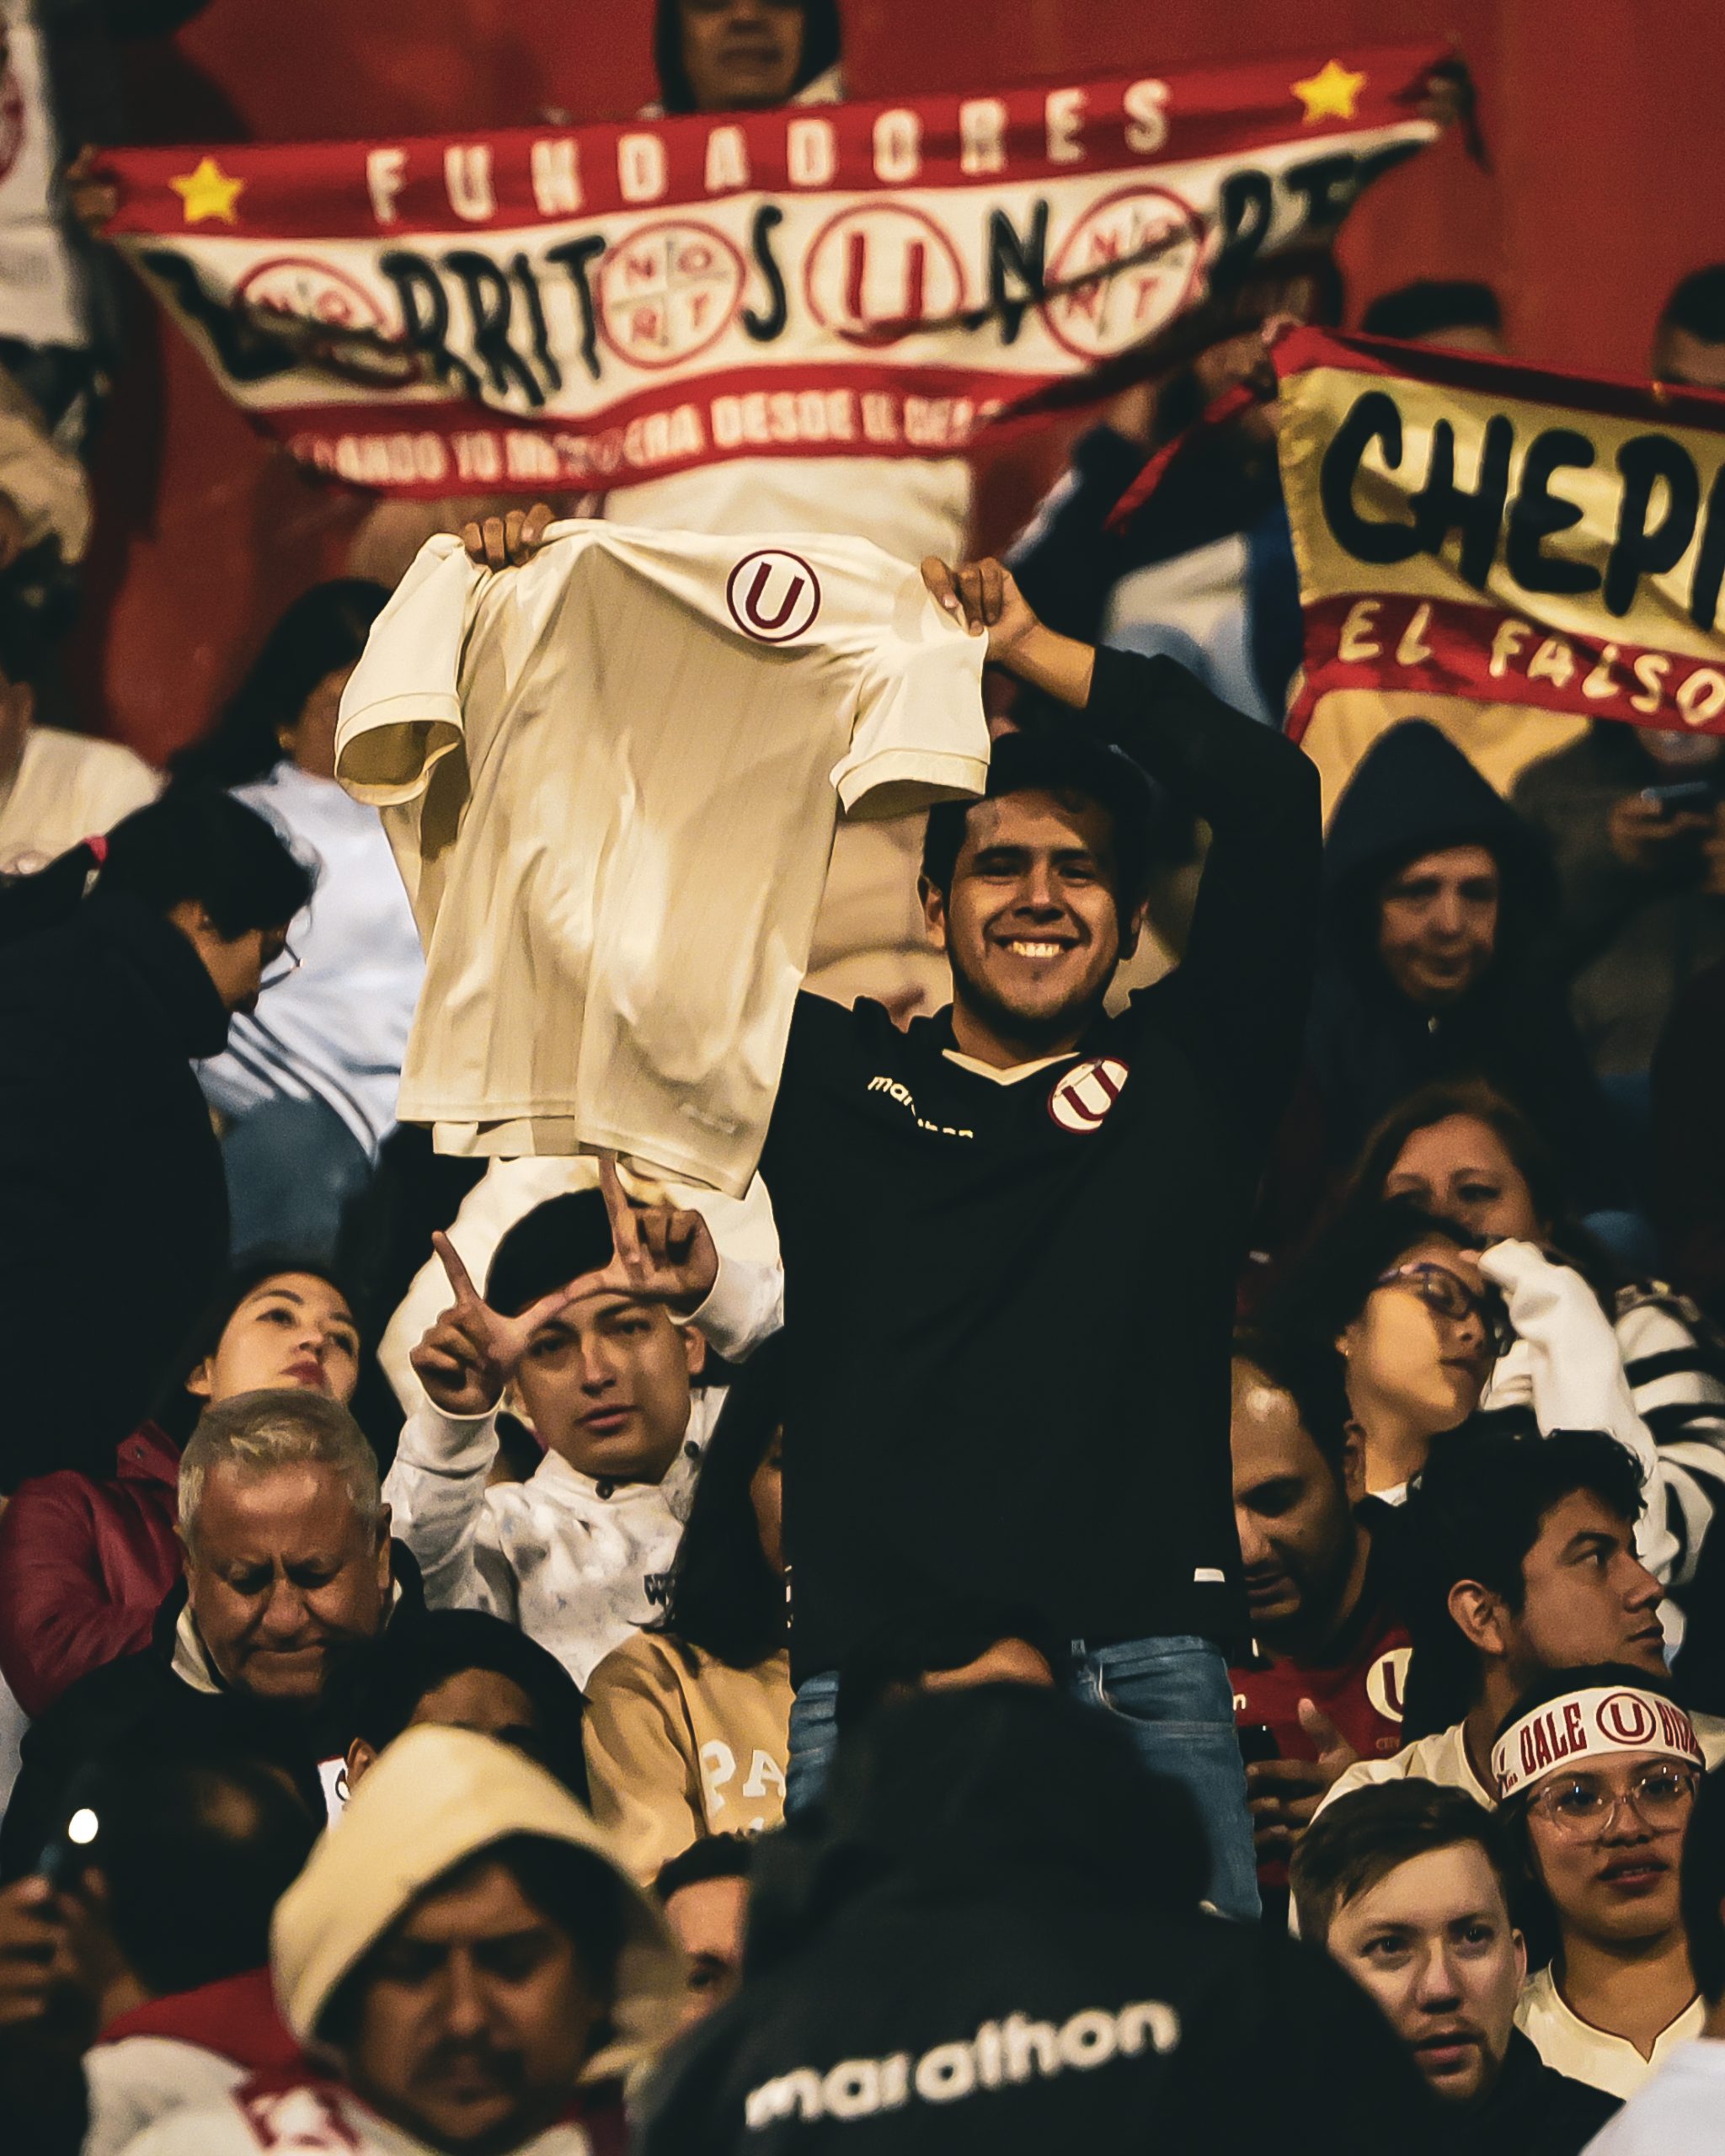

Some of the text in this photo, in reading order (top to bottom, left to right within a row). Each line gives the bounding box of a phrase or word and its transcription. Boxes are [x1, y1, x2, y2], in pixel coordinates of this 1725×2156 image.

[366, 78, 1172, 226] FUNDADORES
[710, 387, 854, 450] DESDE
[742, 558, 809, 633] U
[1338, 600, 1725, 726] EL FALSO
[1519, 1701, 1588, 1777] DALE
[1606, 1700, 1648, 1739] U
[745, 1999, 1179, 2132] marathon
